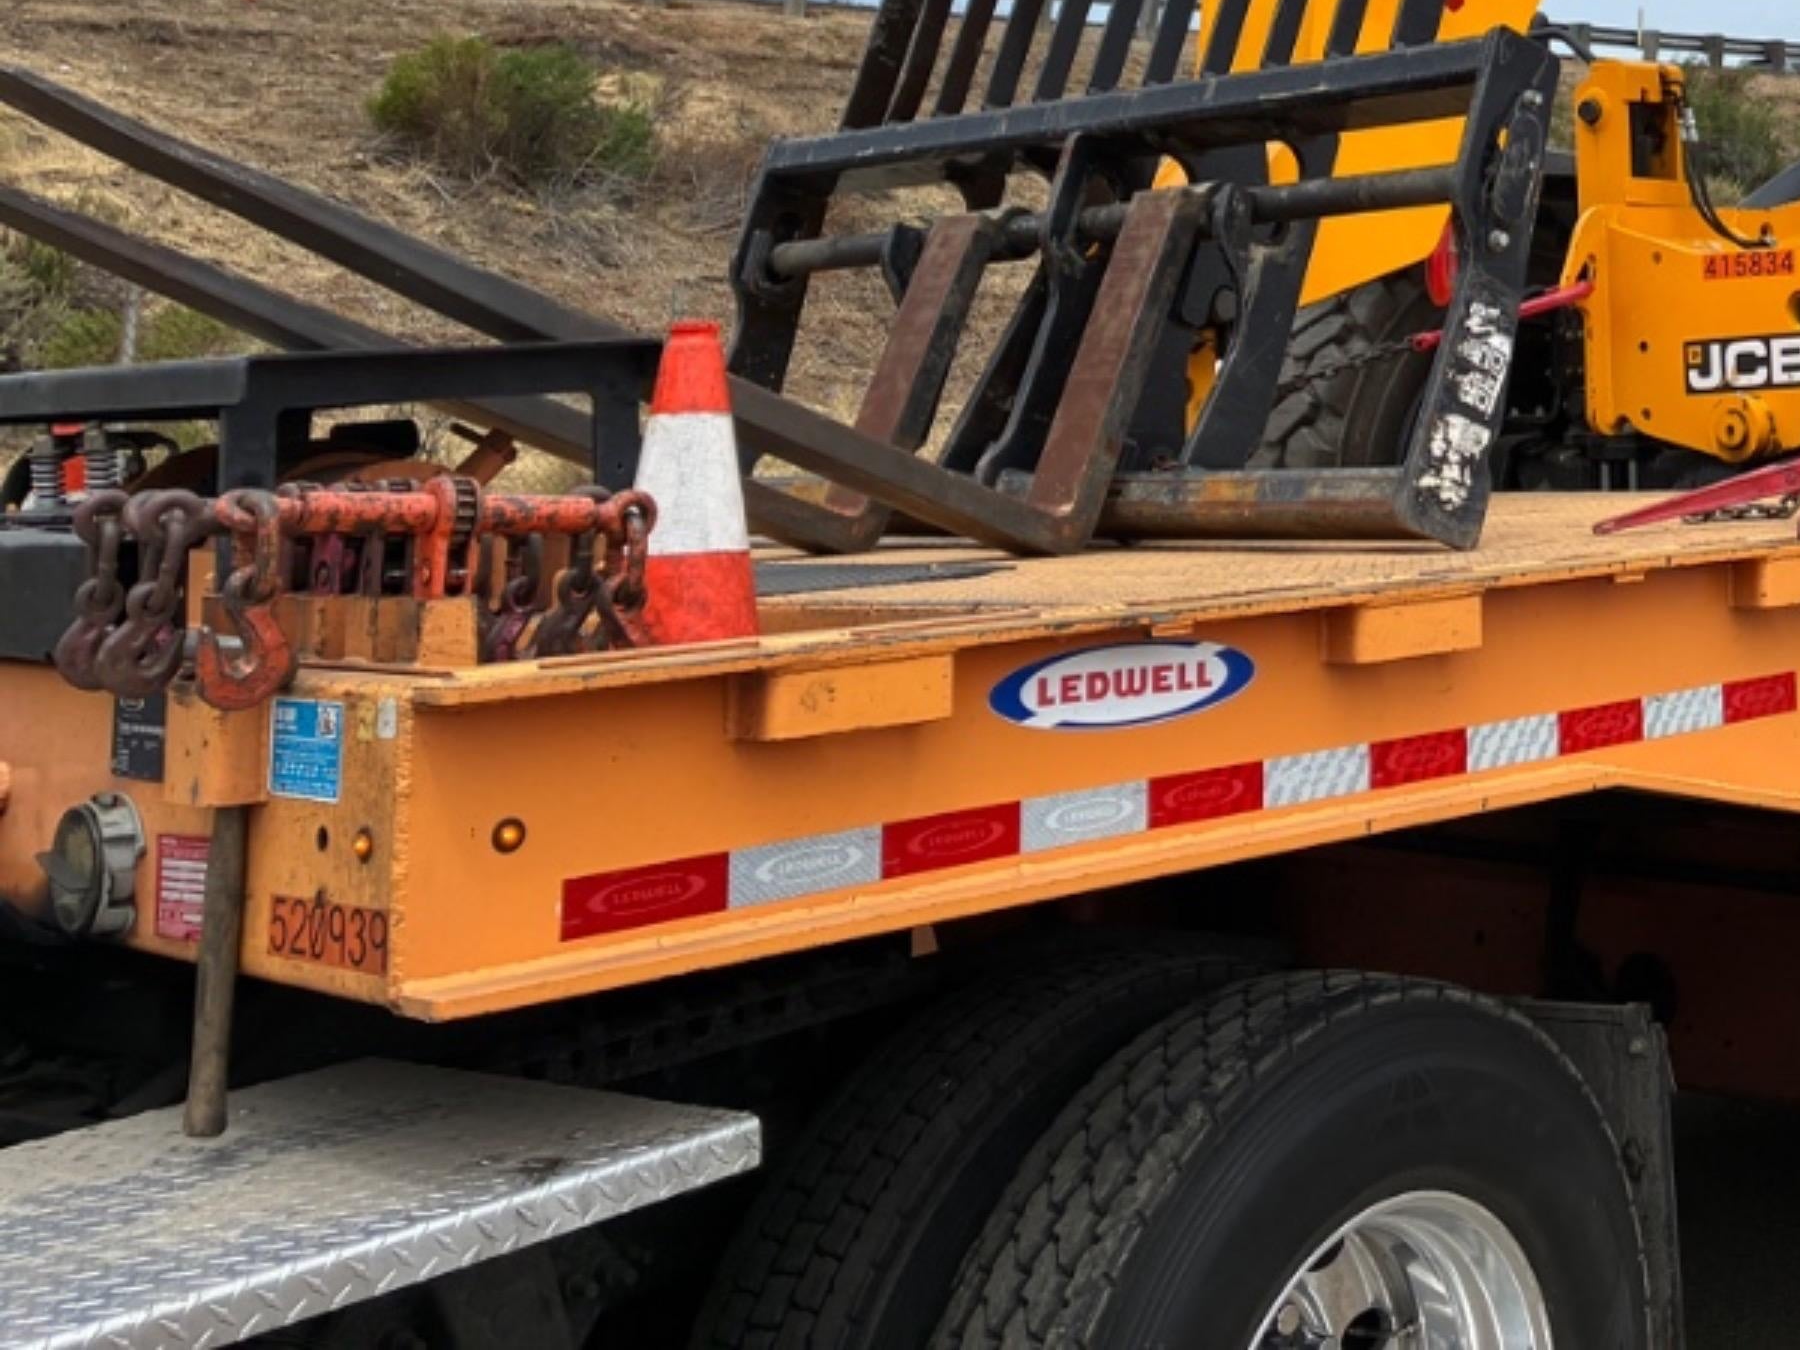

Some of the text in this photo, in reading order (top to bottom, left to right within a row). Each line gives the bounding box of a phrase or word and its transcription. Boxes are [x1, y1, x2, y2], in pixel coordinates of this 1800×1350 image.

[1704, 250, 1794, 279] 415834
[1035, 660, 1213, 707] LEDWELL
[270, 897, 388, 972] 520939
